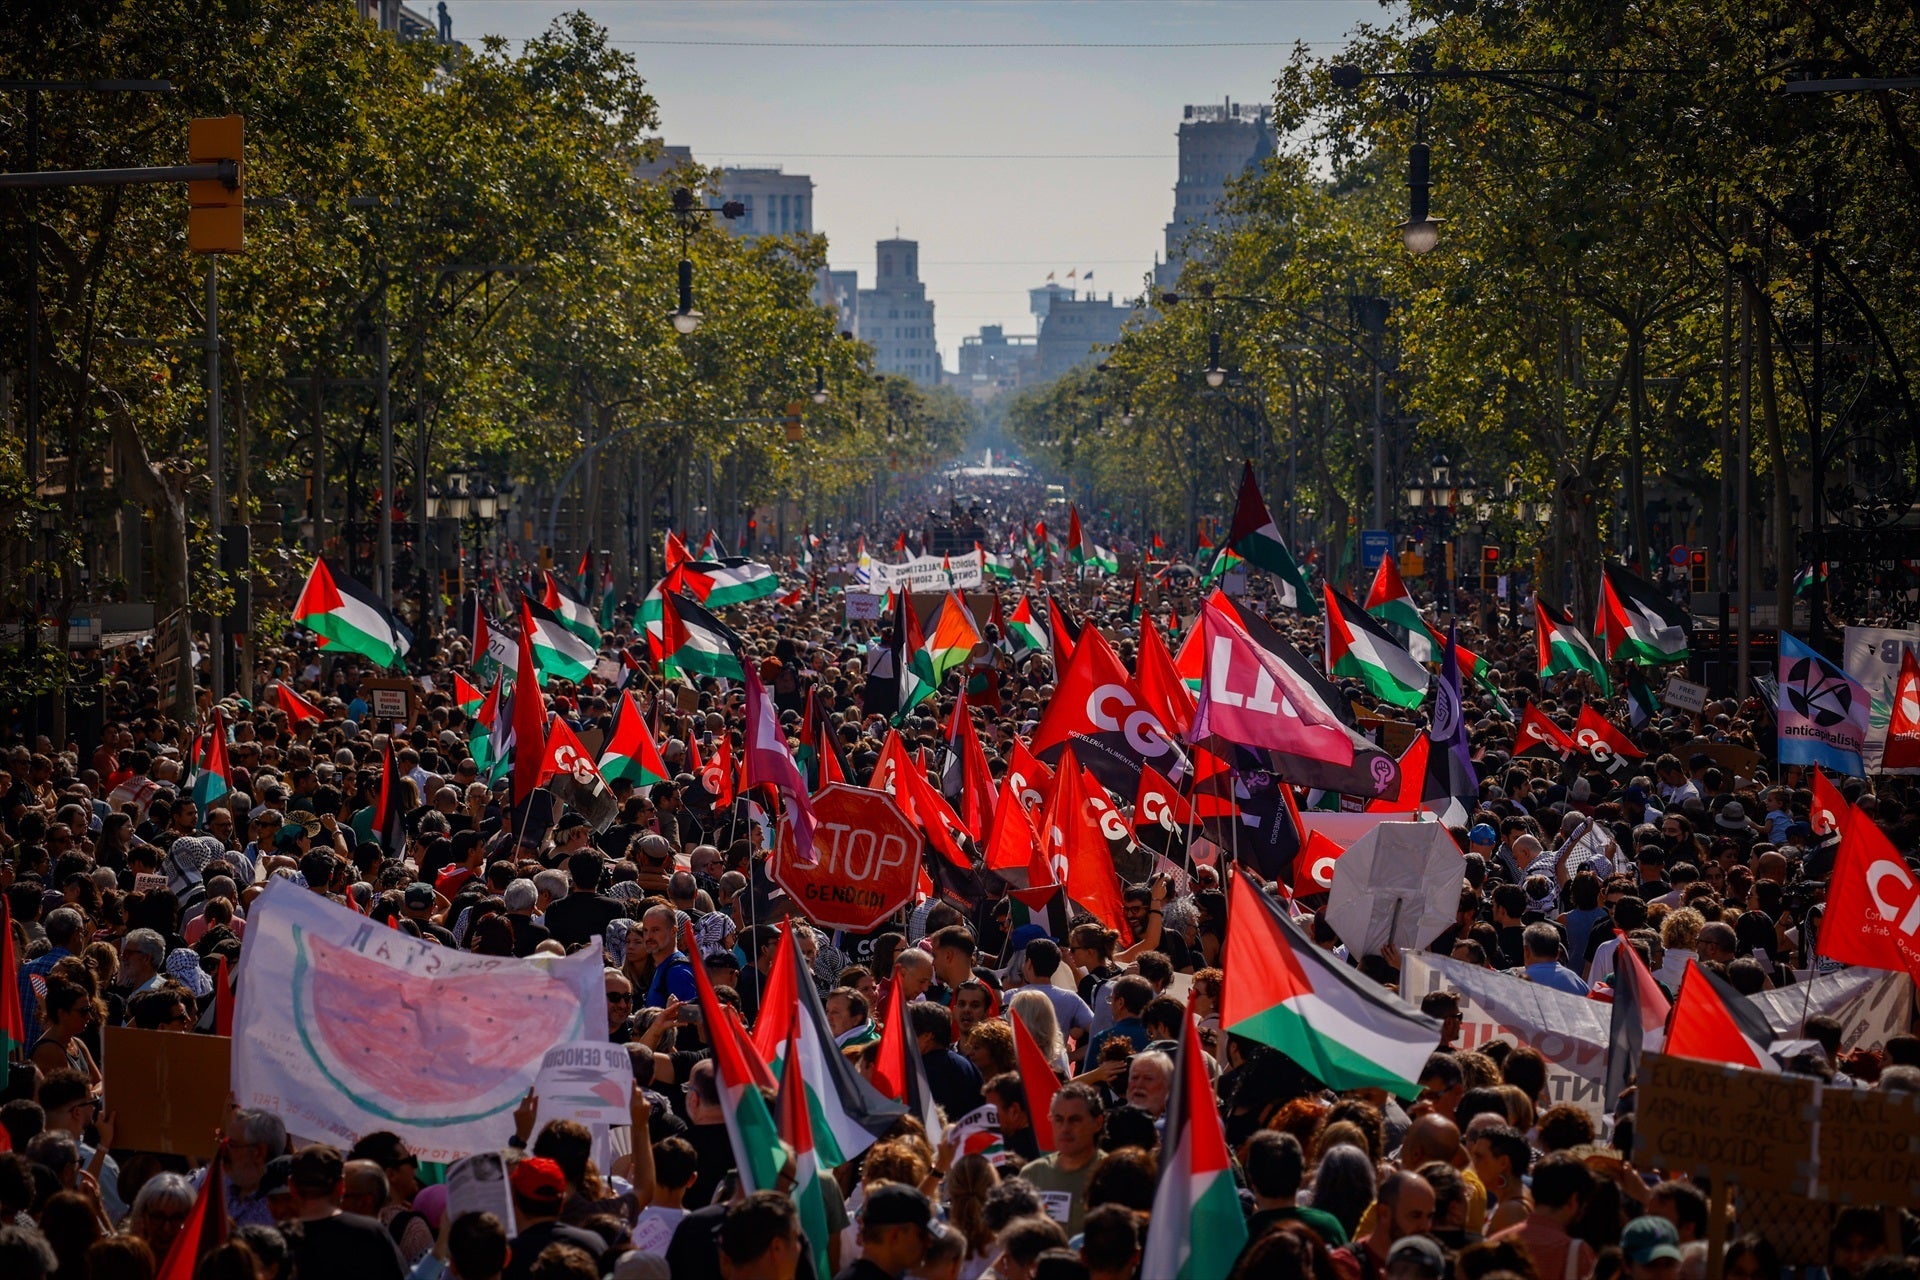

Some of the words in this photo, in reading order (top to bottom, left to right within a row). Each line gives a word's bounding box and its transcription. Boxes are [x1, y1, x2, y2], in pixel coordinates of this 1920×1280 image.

[1667, 691, 1702, 706] PALESTINE
[1678, 685, 1696, 696] FREE
[1526, 722, 1577, 762] CGT
[1577, 728, 1629, 775] CGT
[805, 883, 886, 909] GENOCIDI
[1747, 1075, 1810, 1116] STOP
[1658, 1126, 1777, 1174] GENOCIDE
